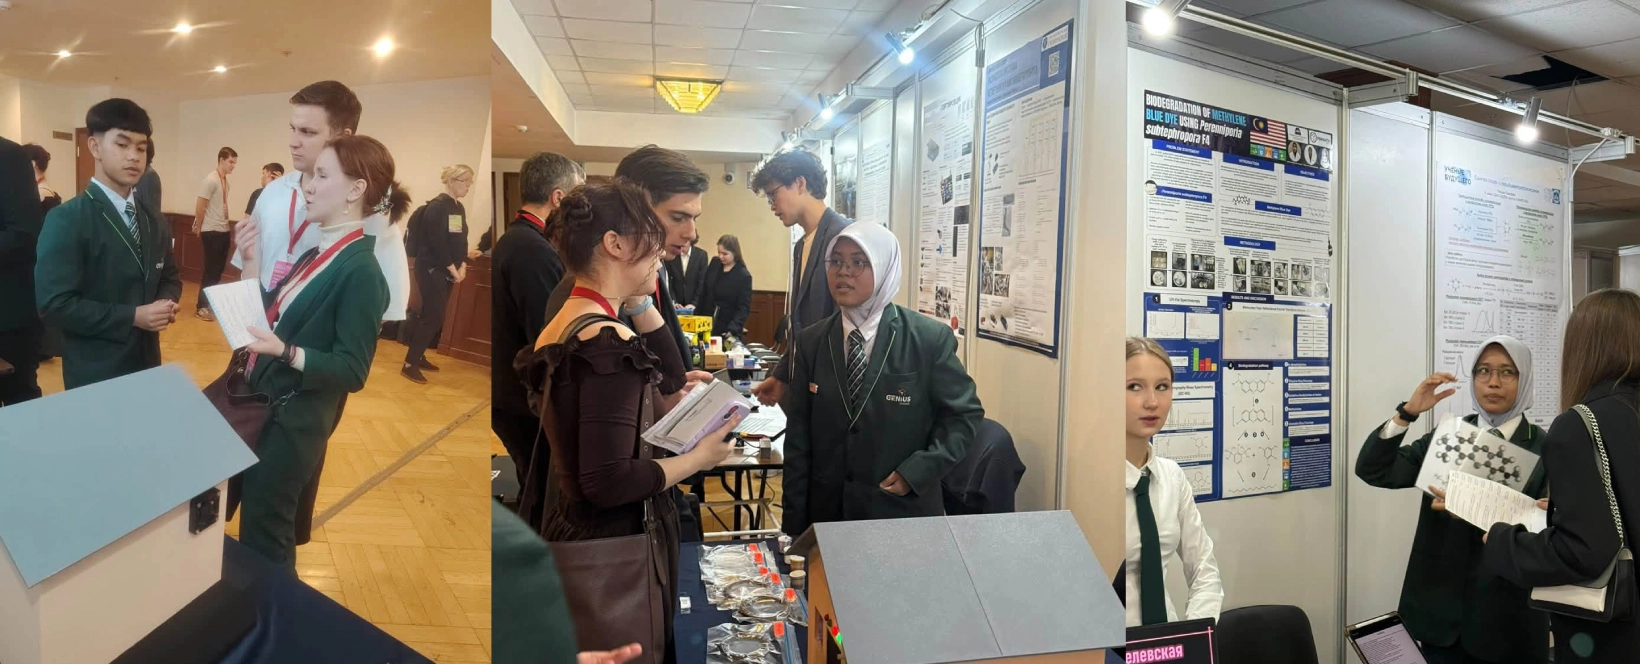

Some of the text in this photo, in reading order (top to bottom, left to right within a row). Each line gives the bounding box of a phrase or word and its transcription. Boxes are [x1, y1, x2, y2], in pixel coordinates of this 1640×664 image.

[1145, 93, 1247, 127] BIODEGRADATION OF METHYLENE
[1145, 124, 1211, 146] subtephropora F4
[1146, 108, 1243, 139] BLUE DYE USING Perenniporia
[1444, 174, 1472, 185] БУДУЩЕГО
